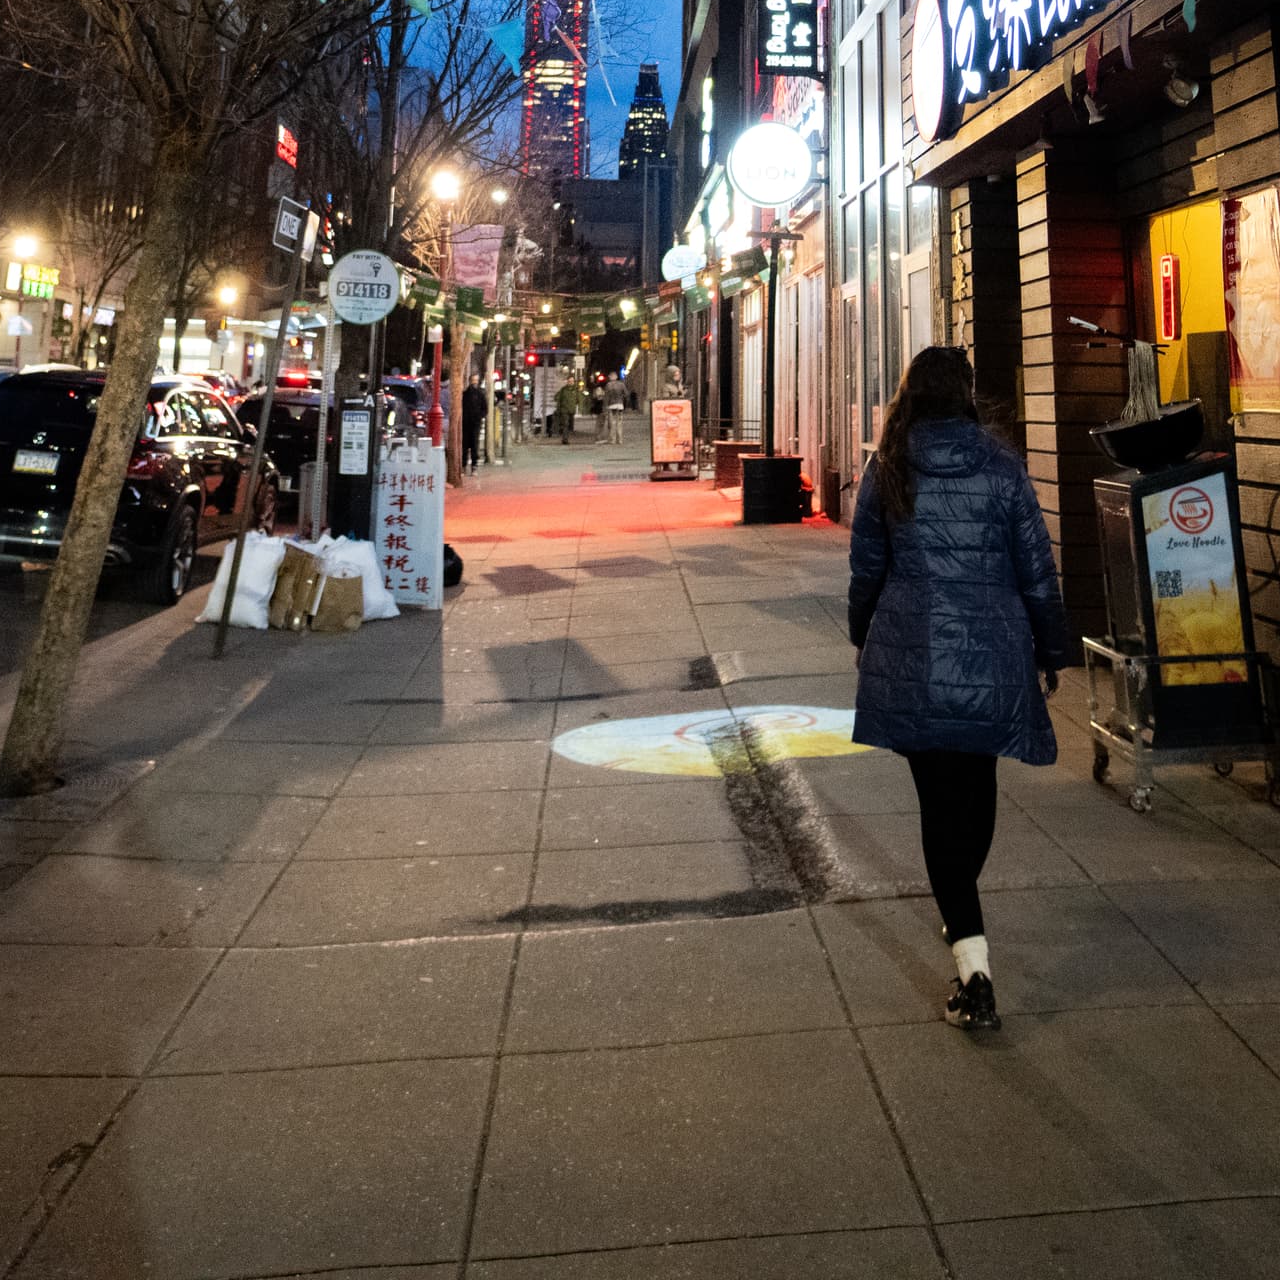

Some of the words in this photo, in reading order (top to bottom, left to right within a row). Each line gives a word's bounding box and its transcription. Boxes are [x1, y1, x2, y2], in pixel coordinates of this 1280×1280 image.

[766, 11, 791, 53] Tang
[338, 281, 389, 299] 914118
[1166, 537, 1191, 550] Love
[1192, 535, 1227, 549] Noodle
